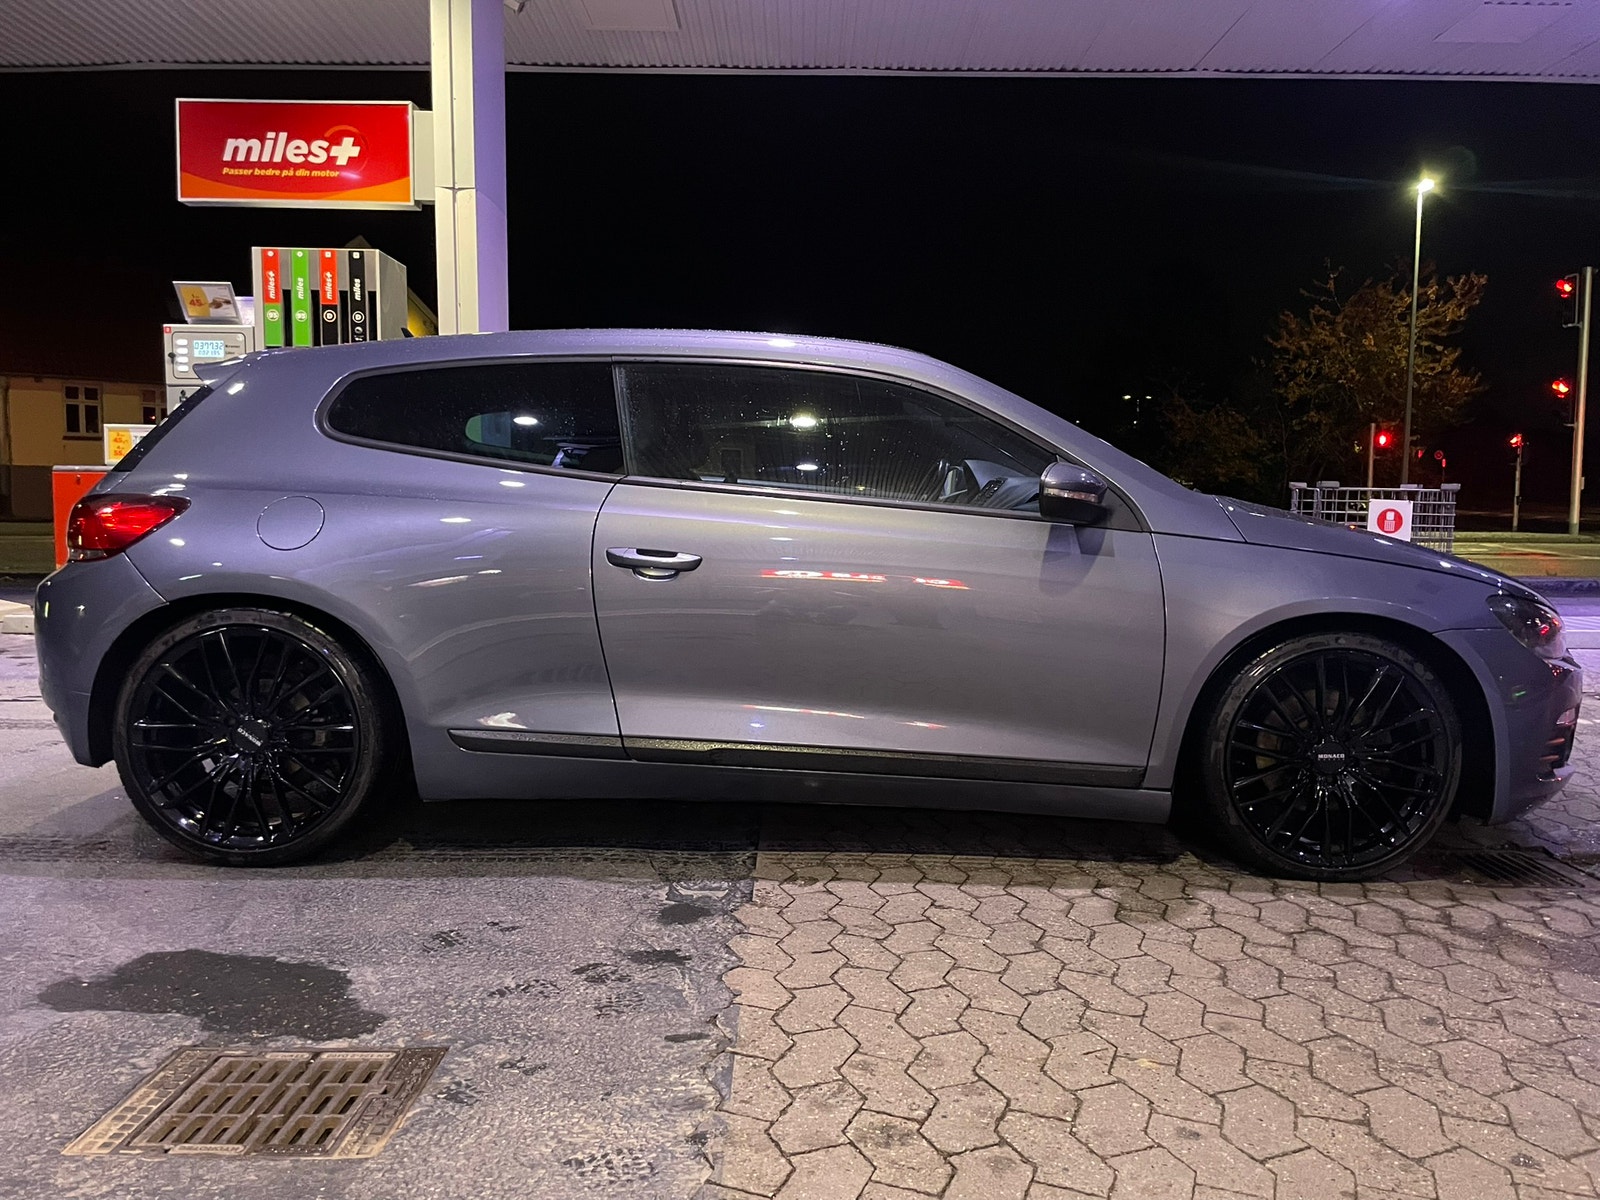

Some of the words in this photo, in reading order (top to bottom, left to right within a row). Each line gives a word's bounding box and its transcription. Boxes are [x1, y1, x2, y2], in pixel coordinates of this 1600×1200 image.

[223, 132, 360, 166] miles+
[223, 167, 253, 175] Passer
[254, 168, 280, 176] bedre
[282, 167, 294, 177] på
[295, 168, 310, 177] din
[311, 169, 339, 177] motor
[268, 271, 276, 299] miles+
[296, 277, 304, 300] miles
[325, 271, 333, 300] miles+
[353, 278, 361, 301] miles
